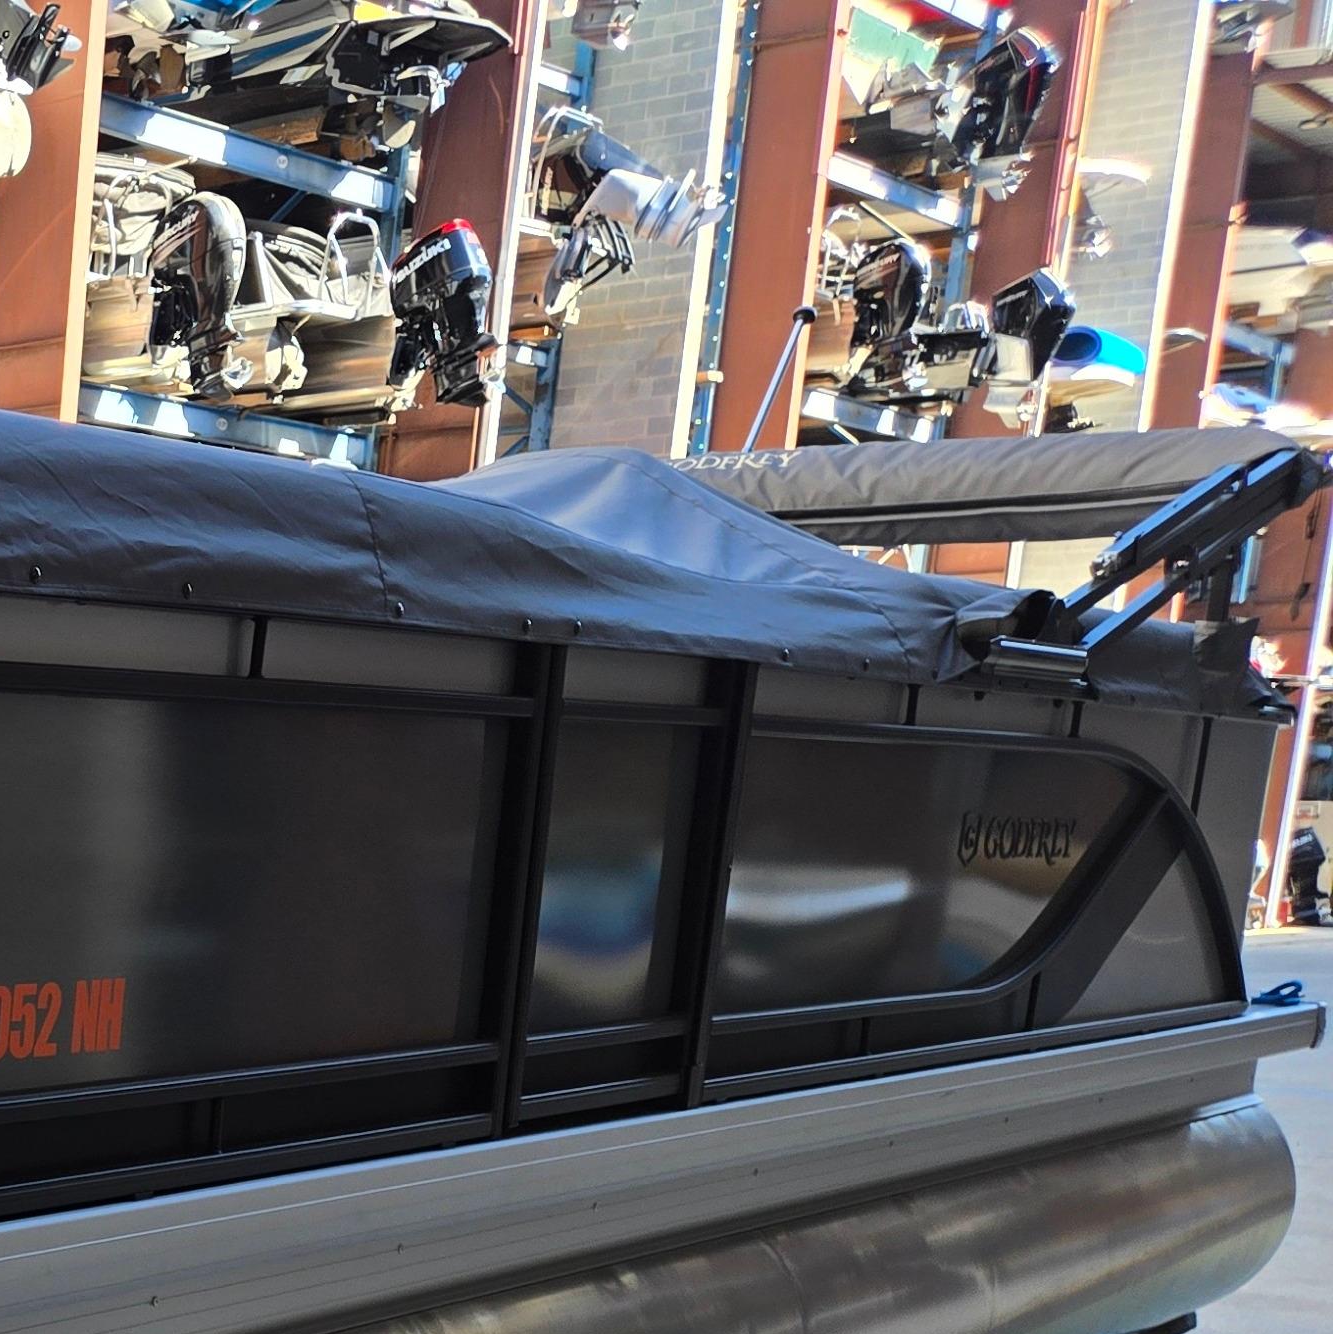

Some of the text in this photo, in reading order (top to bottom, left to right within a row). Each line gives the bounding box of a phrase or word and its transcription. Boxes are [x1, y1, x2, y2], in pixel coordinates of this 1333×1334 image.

[671, 451, 803, 471] ODFREY
[984, 816, 1077, 866] GODFREY
[71, 977, 126, 1054] NH
